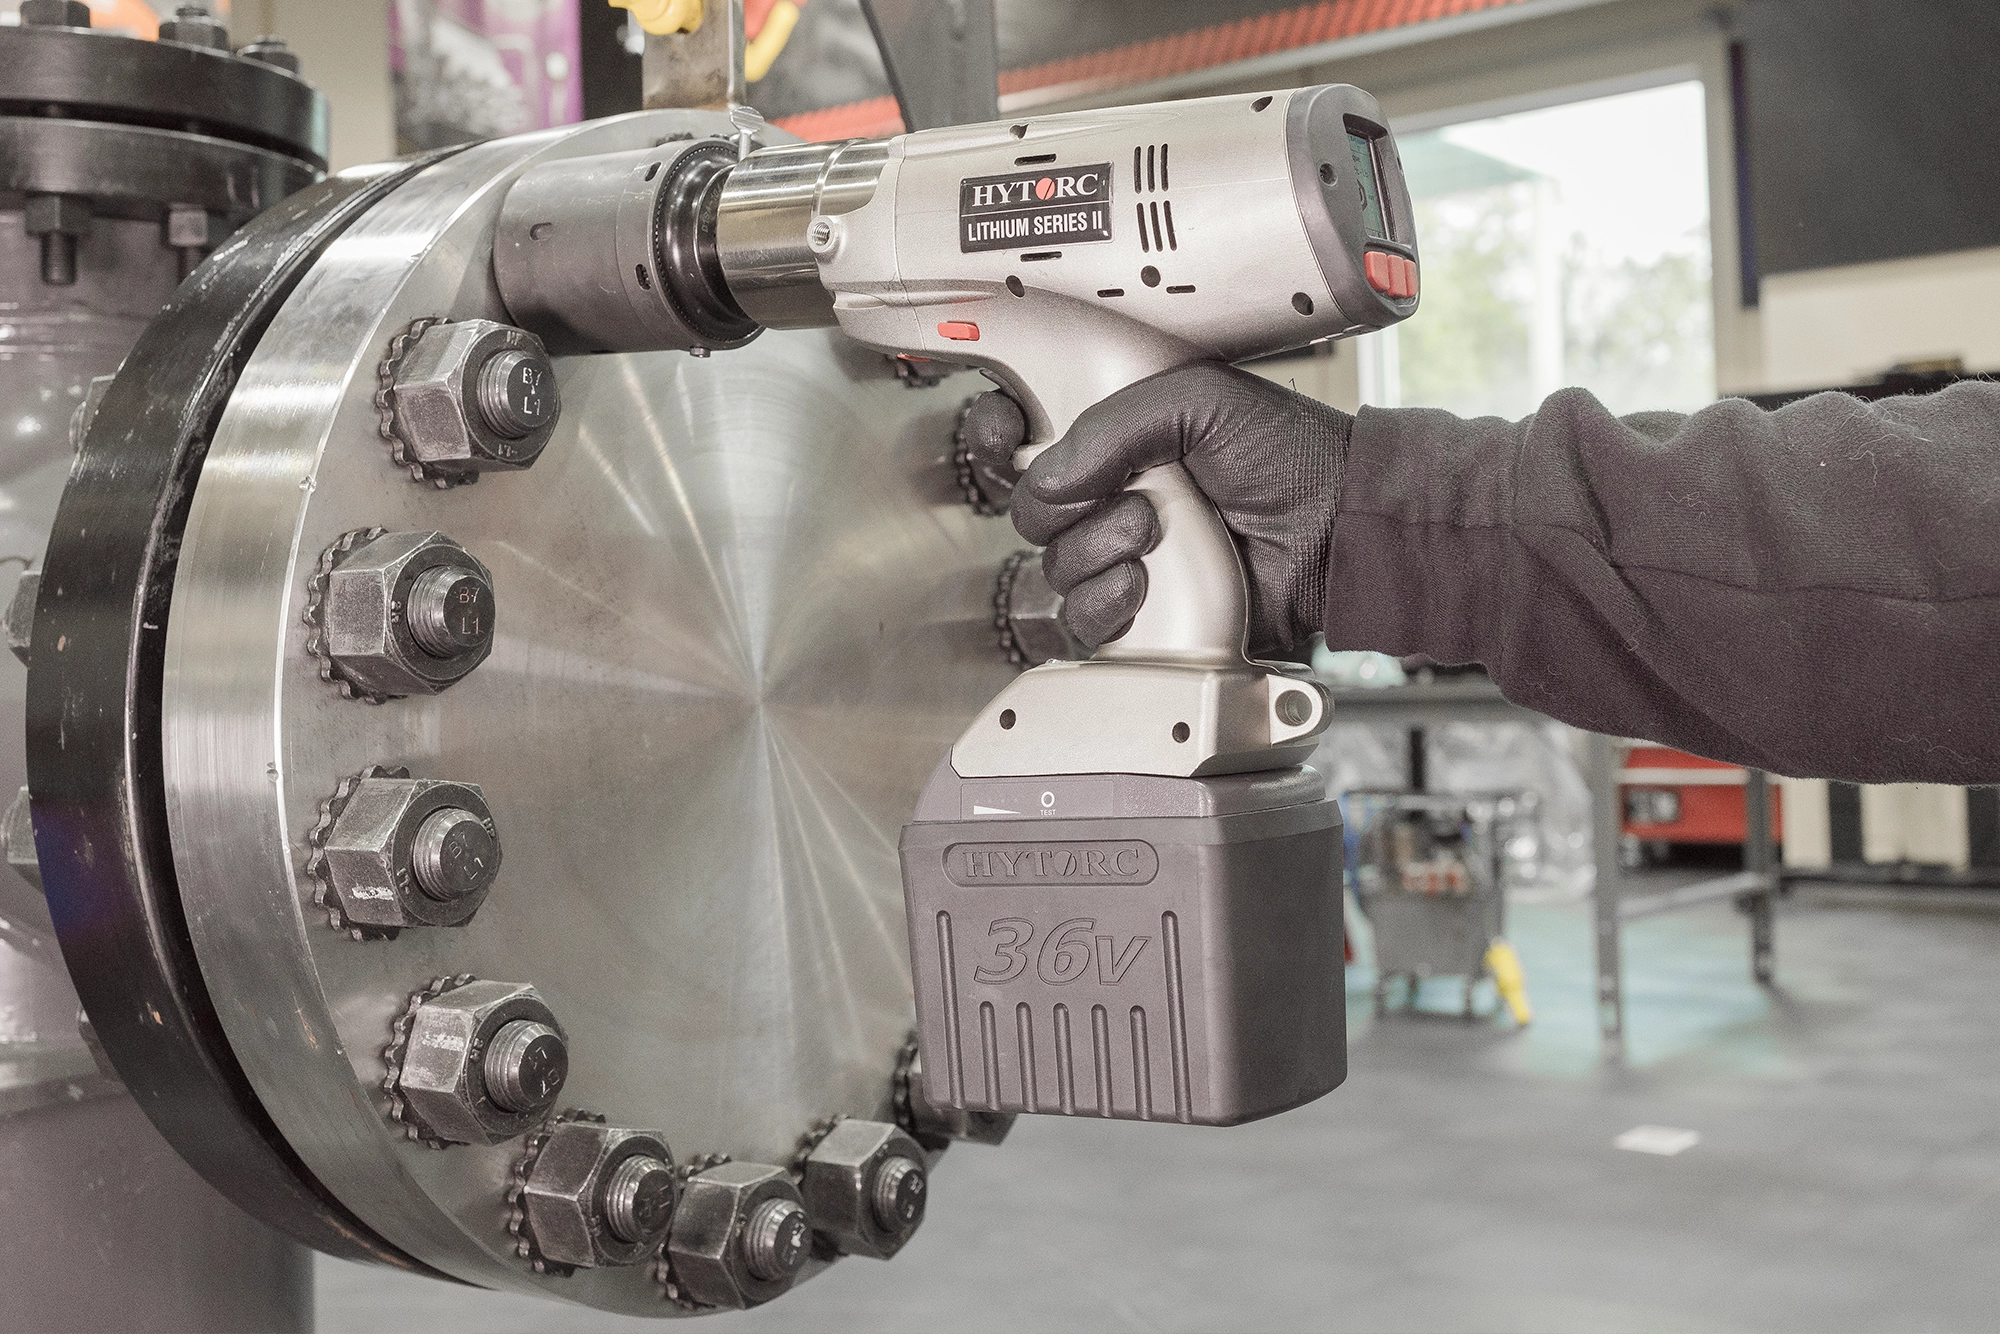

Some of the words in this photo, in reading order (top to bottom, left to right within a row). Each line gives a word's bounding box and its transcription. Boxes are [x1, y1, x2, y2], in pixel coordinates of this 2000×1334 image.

[968, 217, 1029, 242] LITHIUM
[1033, 211, 1088, 236] SERIES
[1092, 210, 1103, 230] II
[459, 586, 480, 603] B7
[963, 848, 1140, 878] HYTORC
